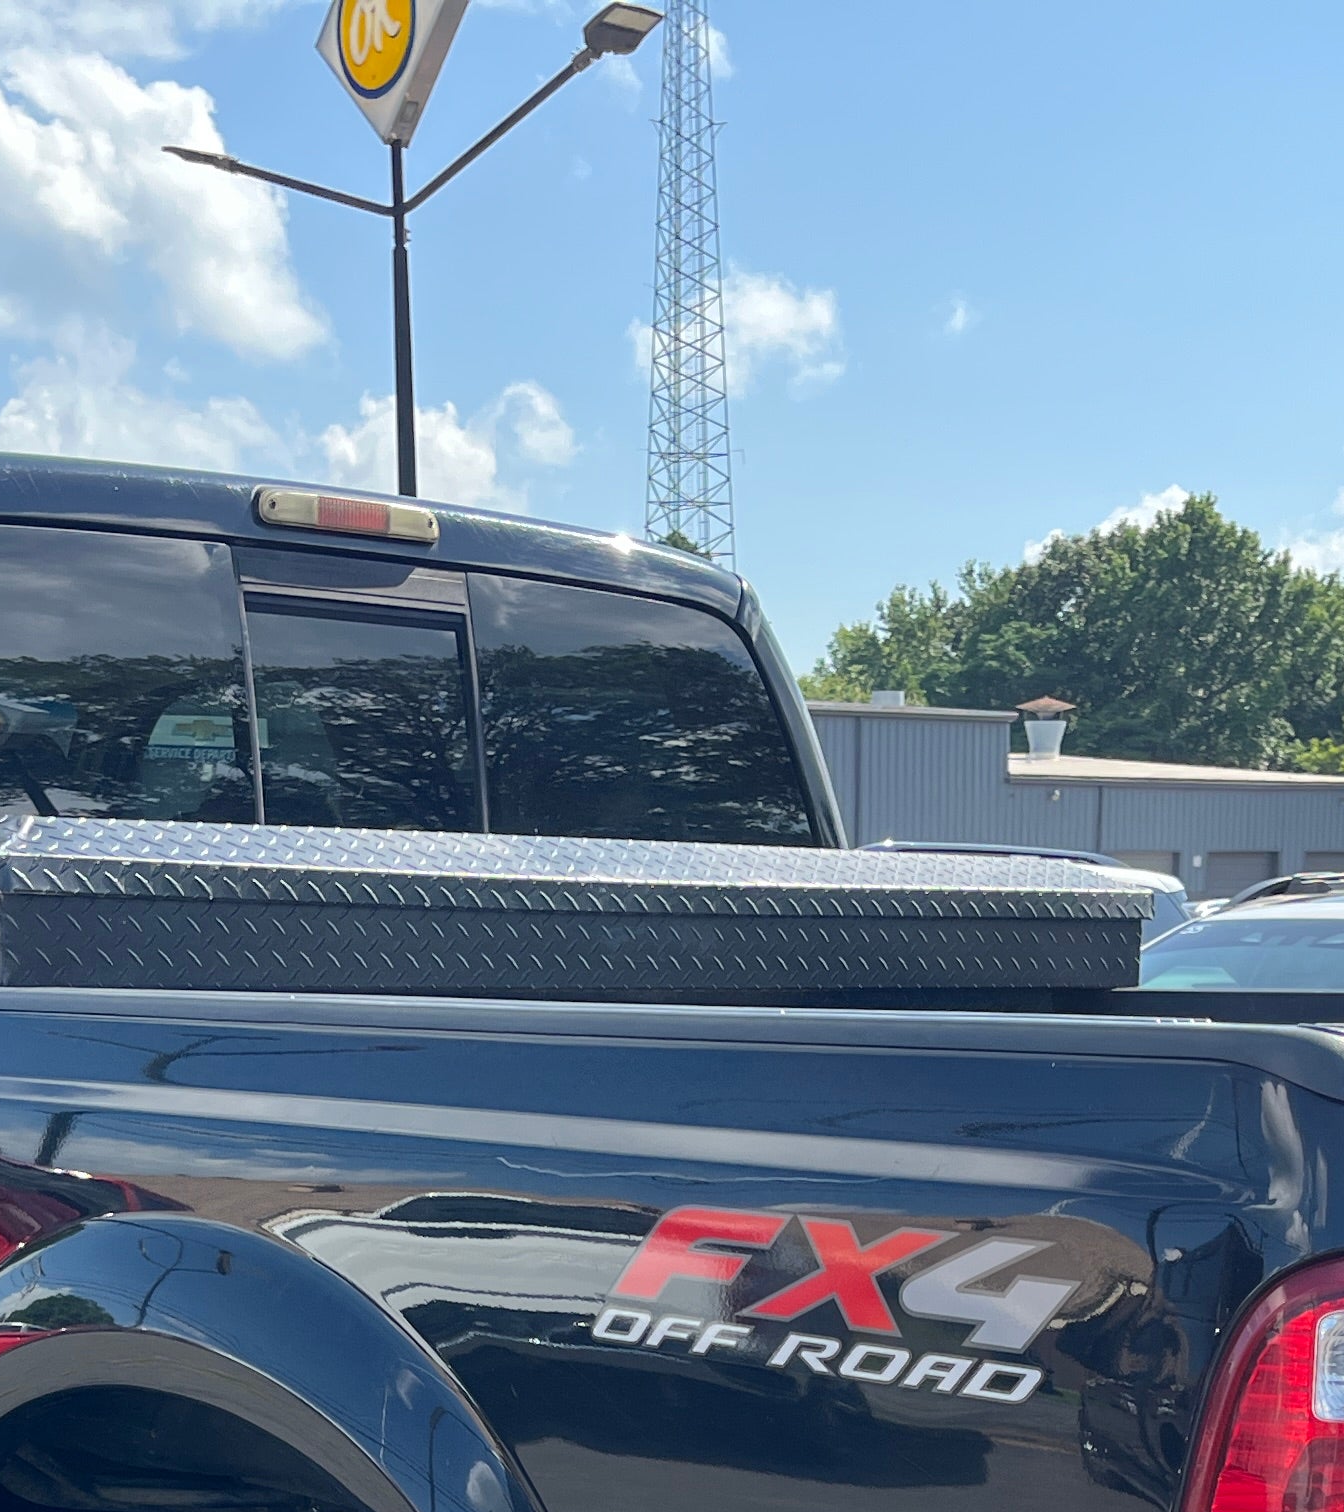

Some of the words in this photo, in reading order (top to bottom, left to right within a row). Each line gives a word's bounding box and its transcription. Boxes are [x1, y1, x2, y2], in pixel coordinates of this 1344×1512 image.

[608, 1205, 1081, 1353] FX4
[592, 1309, 754, 1354] OFF
[766, 1334, 1045, 1404] ROAD
